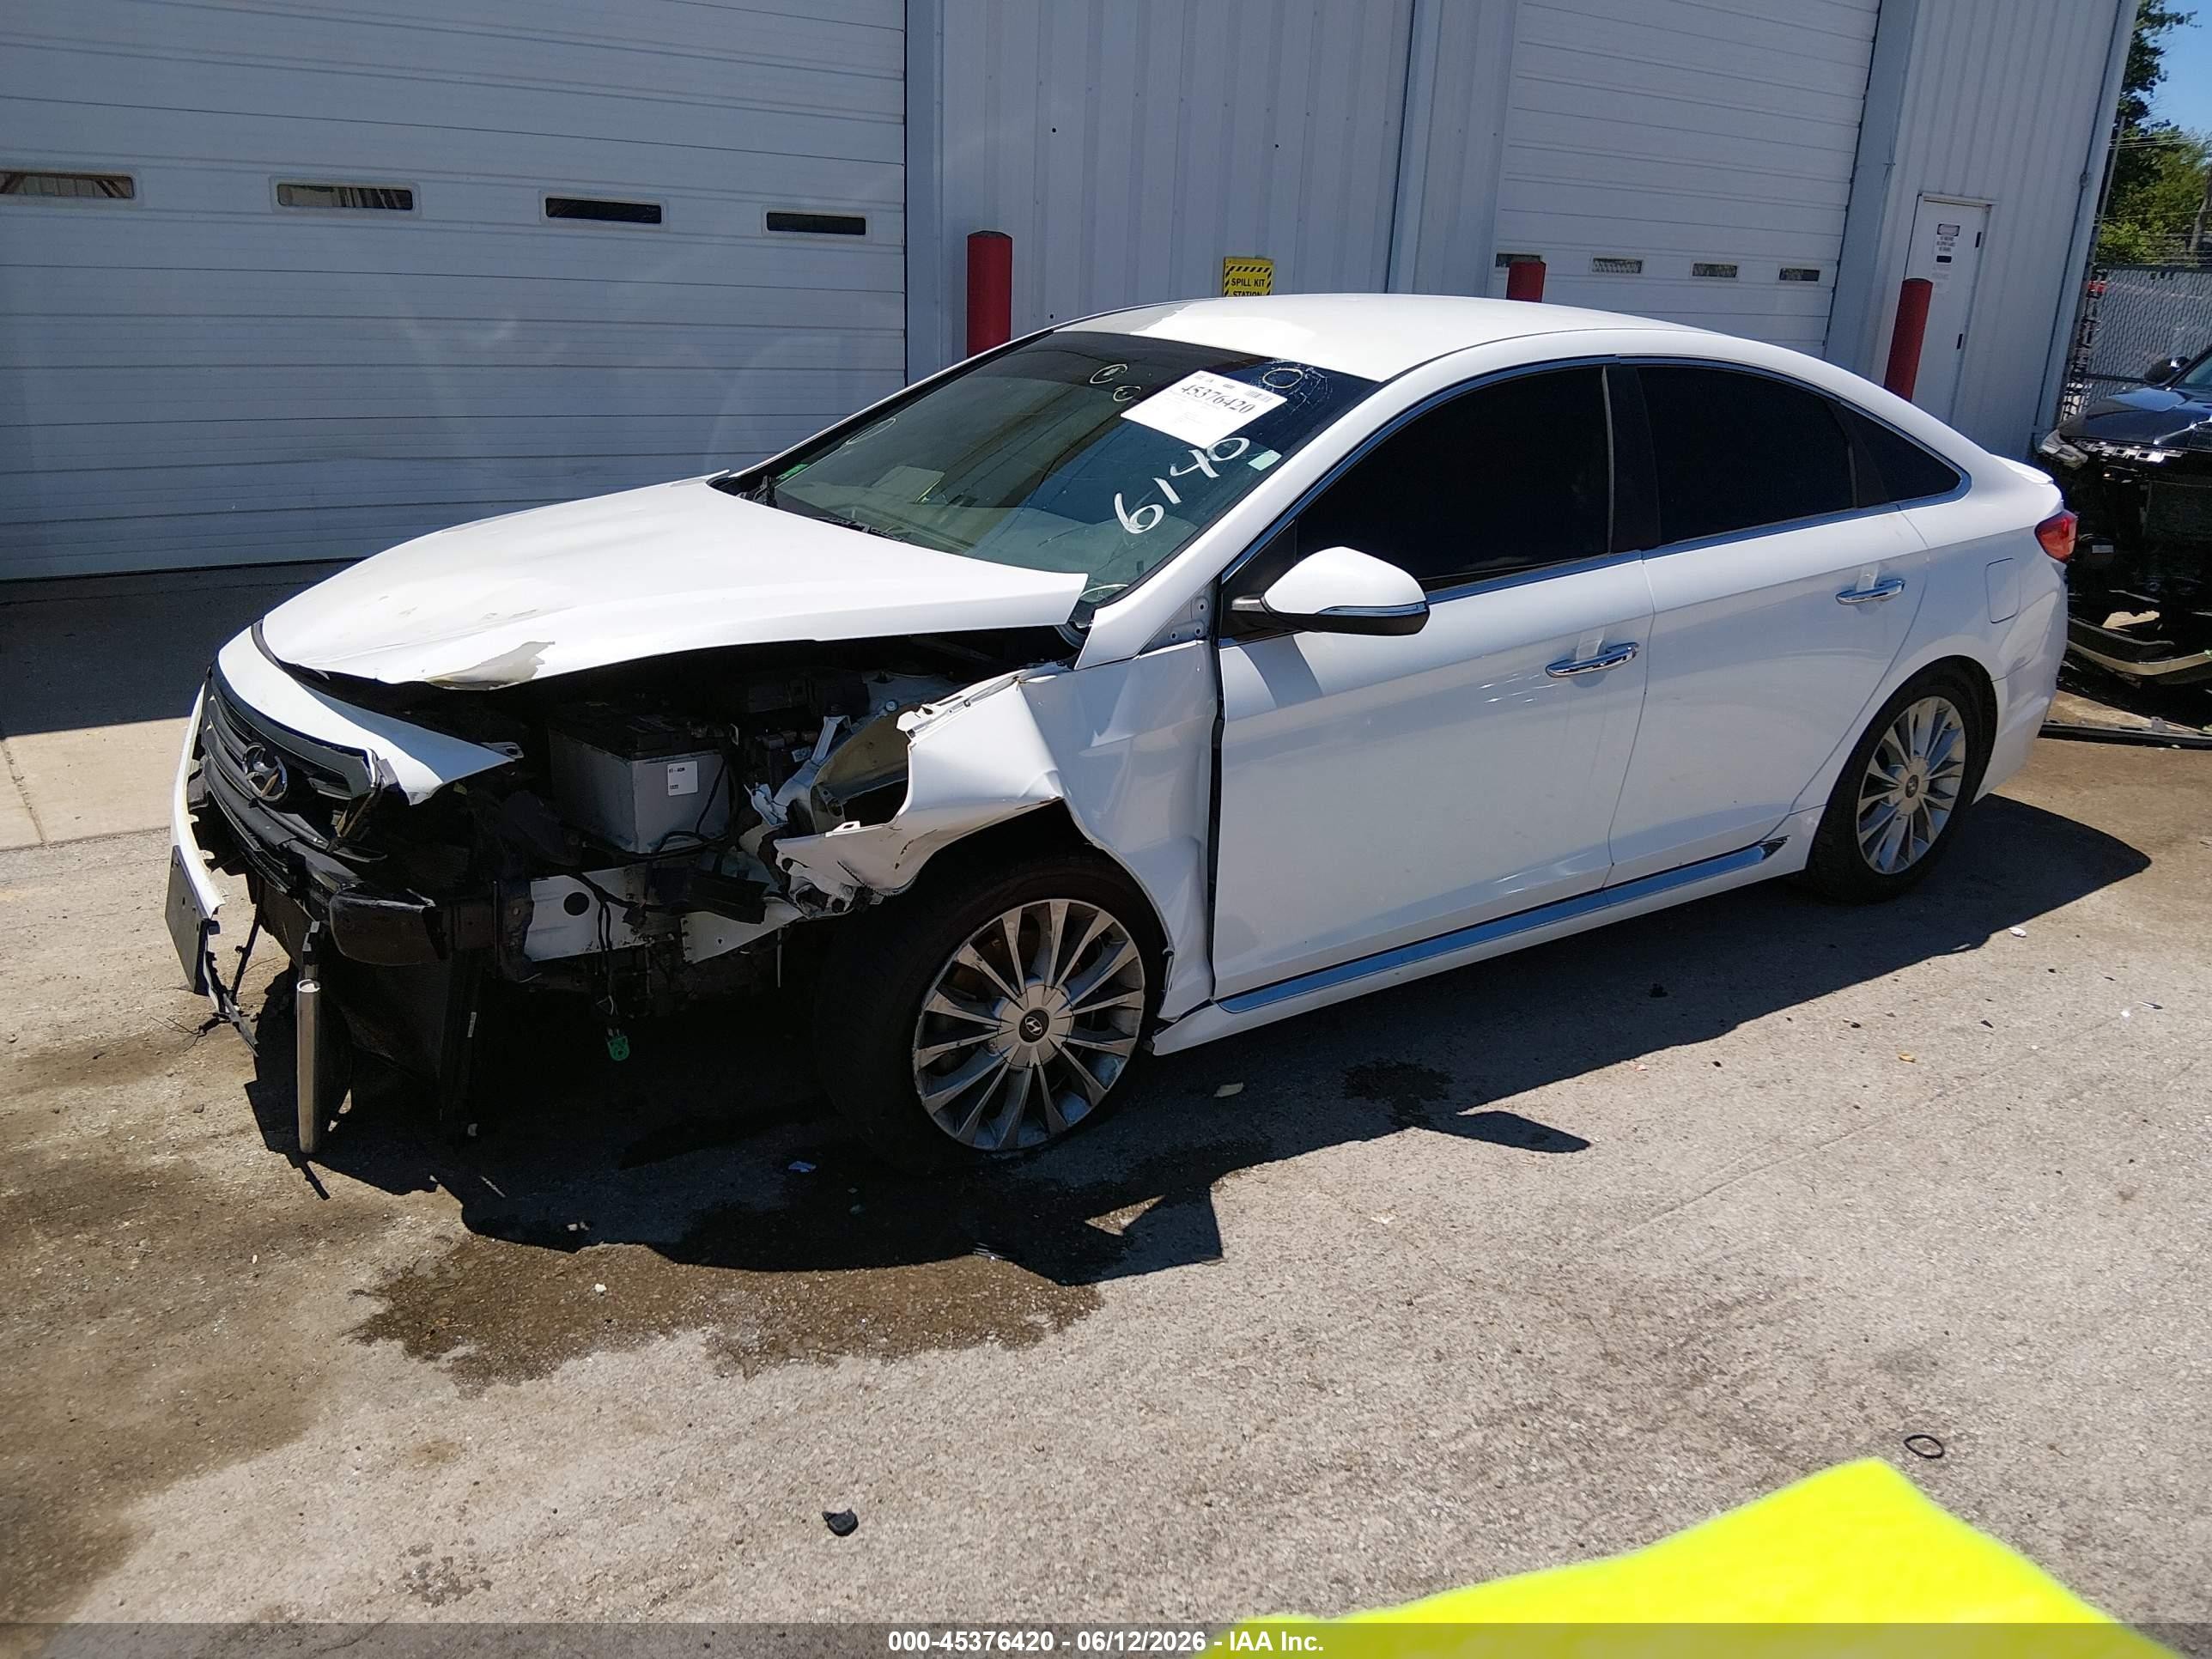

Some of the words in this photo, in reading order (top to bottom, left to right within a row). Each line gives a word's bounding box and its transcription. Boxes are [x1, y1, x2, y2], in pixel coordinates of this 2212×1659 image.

[1231, 277, 1251, 287] SPILL
[1254, 278, 1266, 288] KIT
[1181, 384, 1256, 414] 45376420
[1114, 437, 1250, 534] 6140
